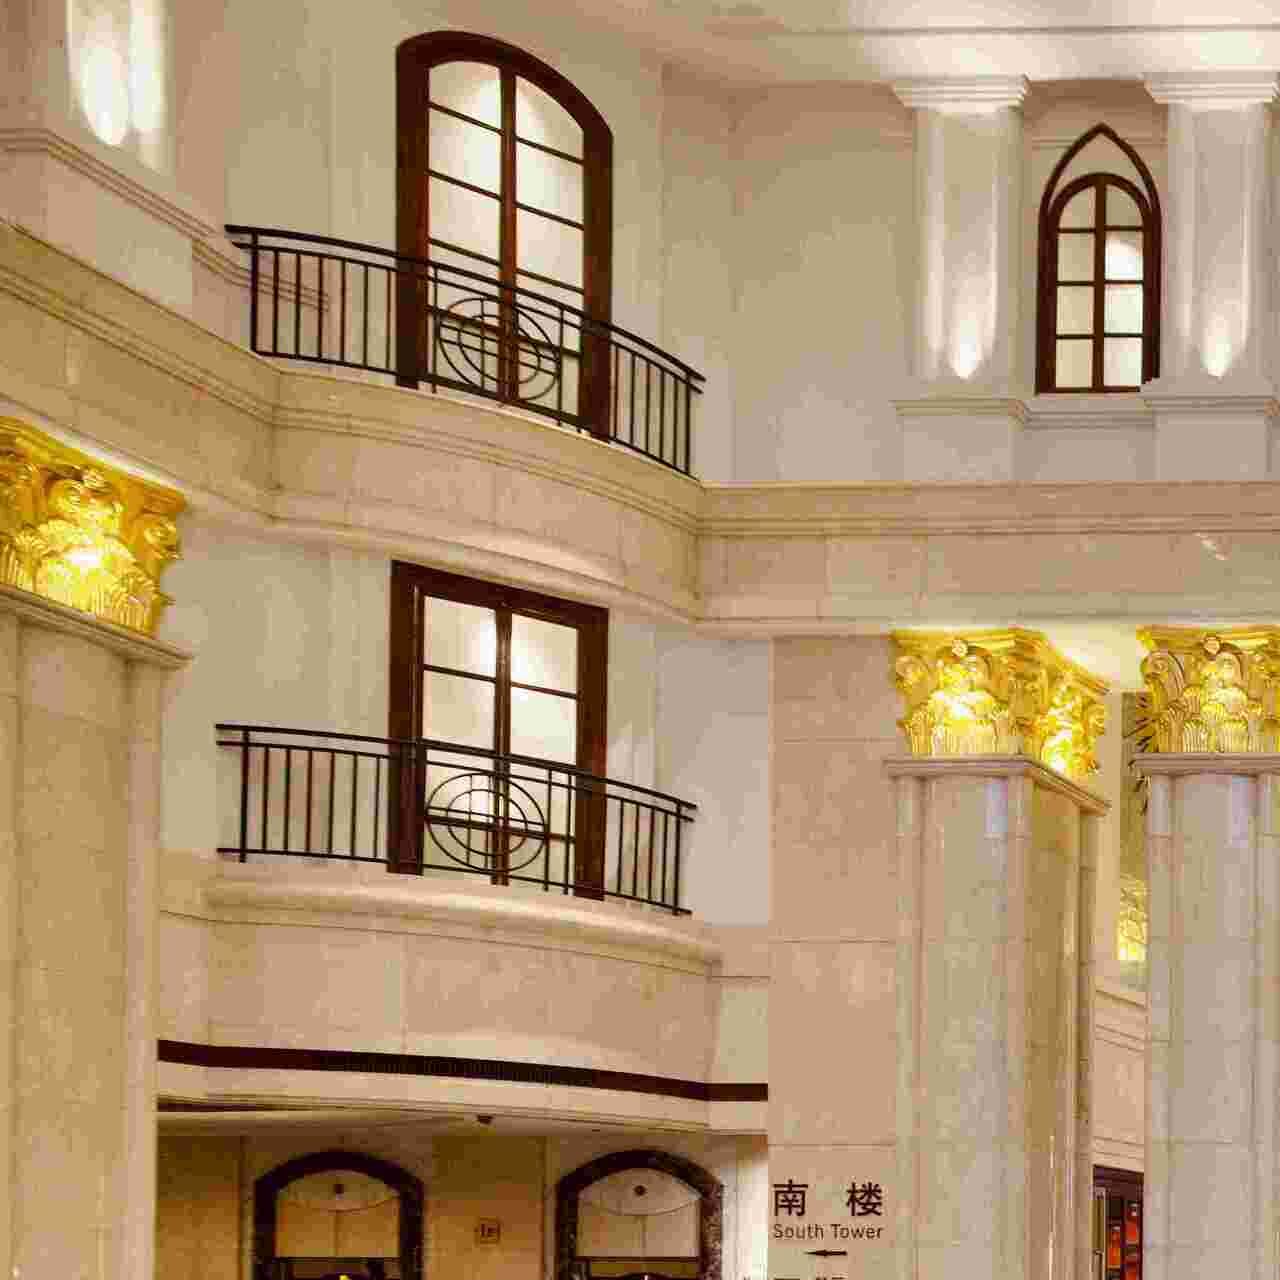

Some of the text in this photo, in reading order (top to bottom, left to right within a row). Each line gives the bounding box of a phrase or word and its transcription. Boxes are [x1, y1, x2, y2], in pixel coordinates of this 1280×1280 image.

[773, 1179, 883, 1217] 南楼
[773, 1224, 882, 1239] South Tower
